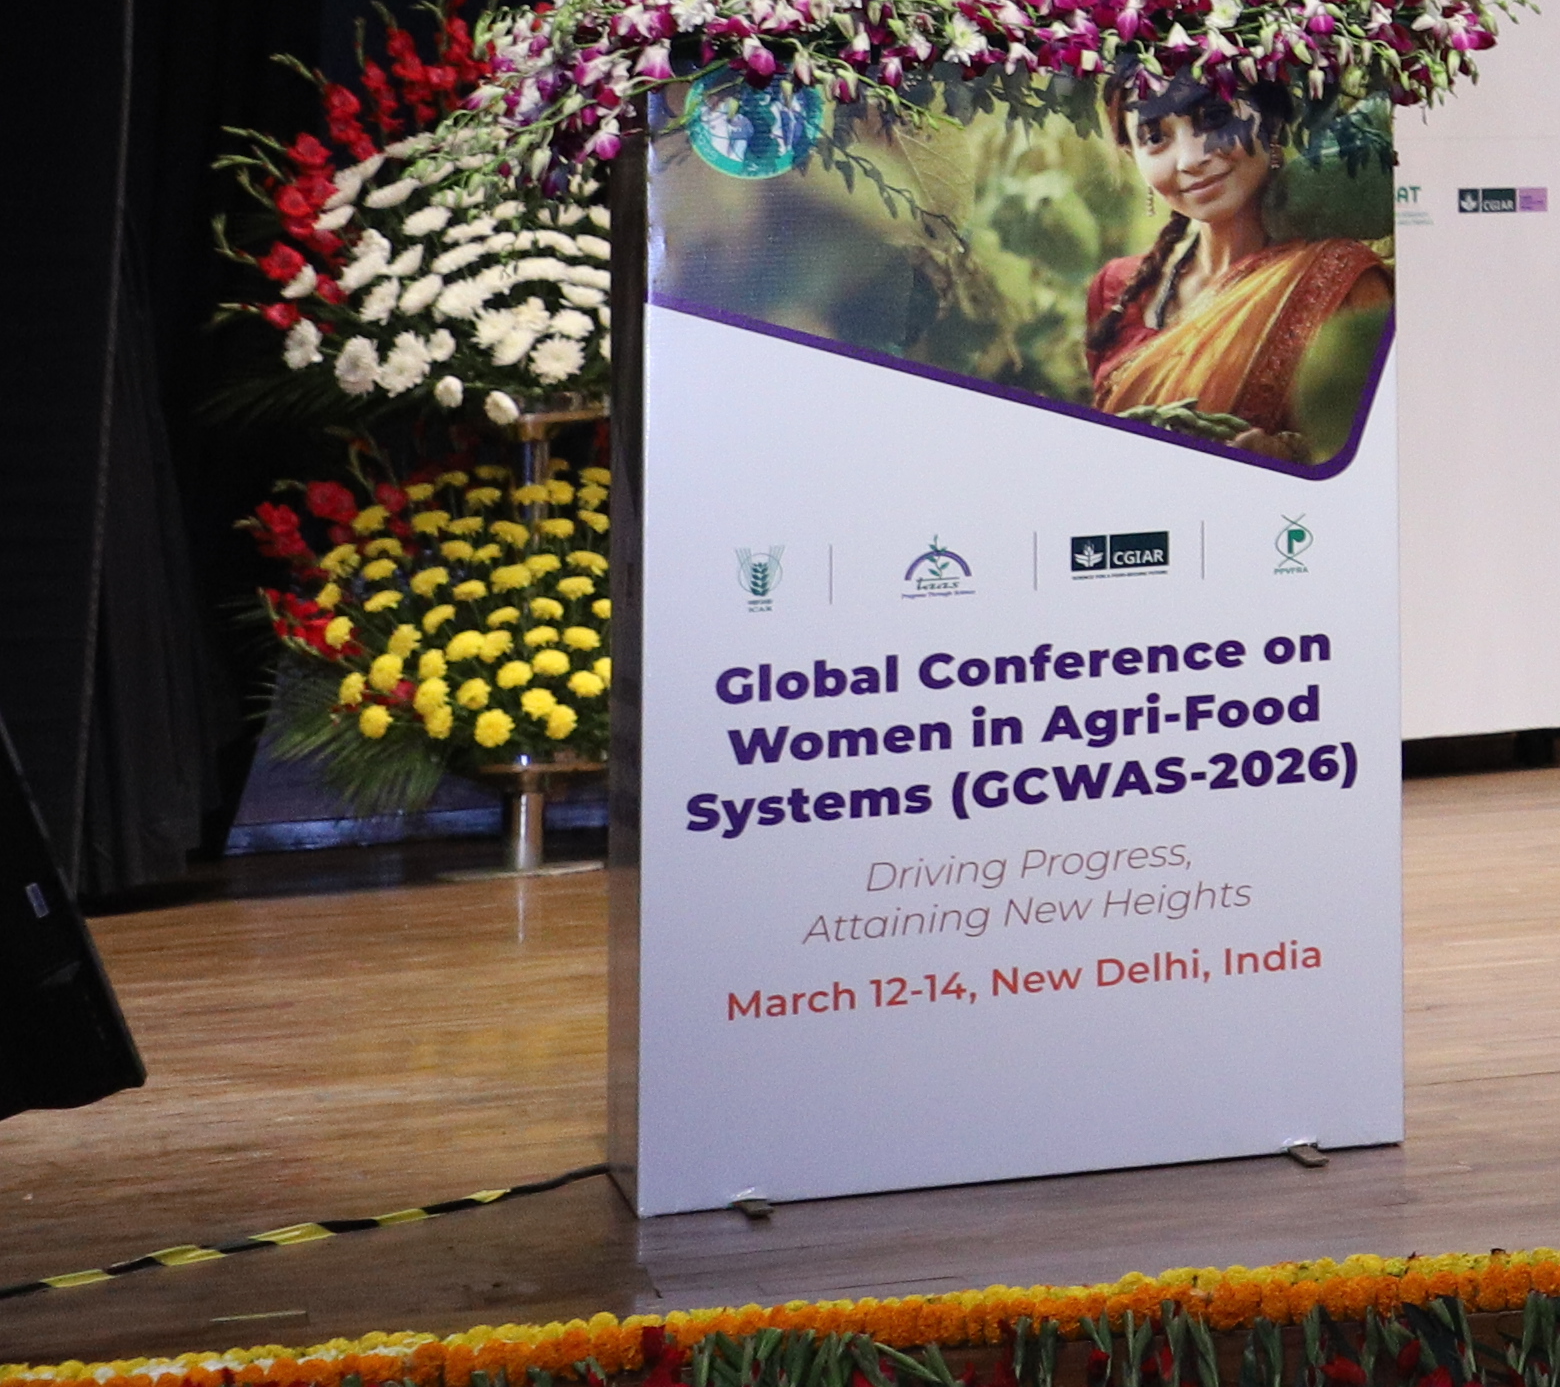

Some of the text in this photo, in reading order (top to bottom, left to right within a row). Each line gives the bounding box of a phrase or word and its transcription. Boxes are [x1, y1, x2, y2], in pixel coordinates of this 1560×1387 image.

[1112, 549, 1164, 565] CGIAR
[715, 633, 1331, 705] Global Conference on
[727, 684, 1320, 766] Women in Agri-Food
[686, 741, 1358, 840] Systems (GCWAS-2026)
[865, 843, 1192, 893] Driving Progress,
[801, 880, 1252, 945] Attaining New Heights
[727, 939, 1322, 1021] March 12-14, New Delhi, India
